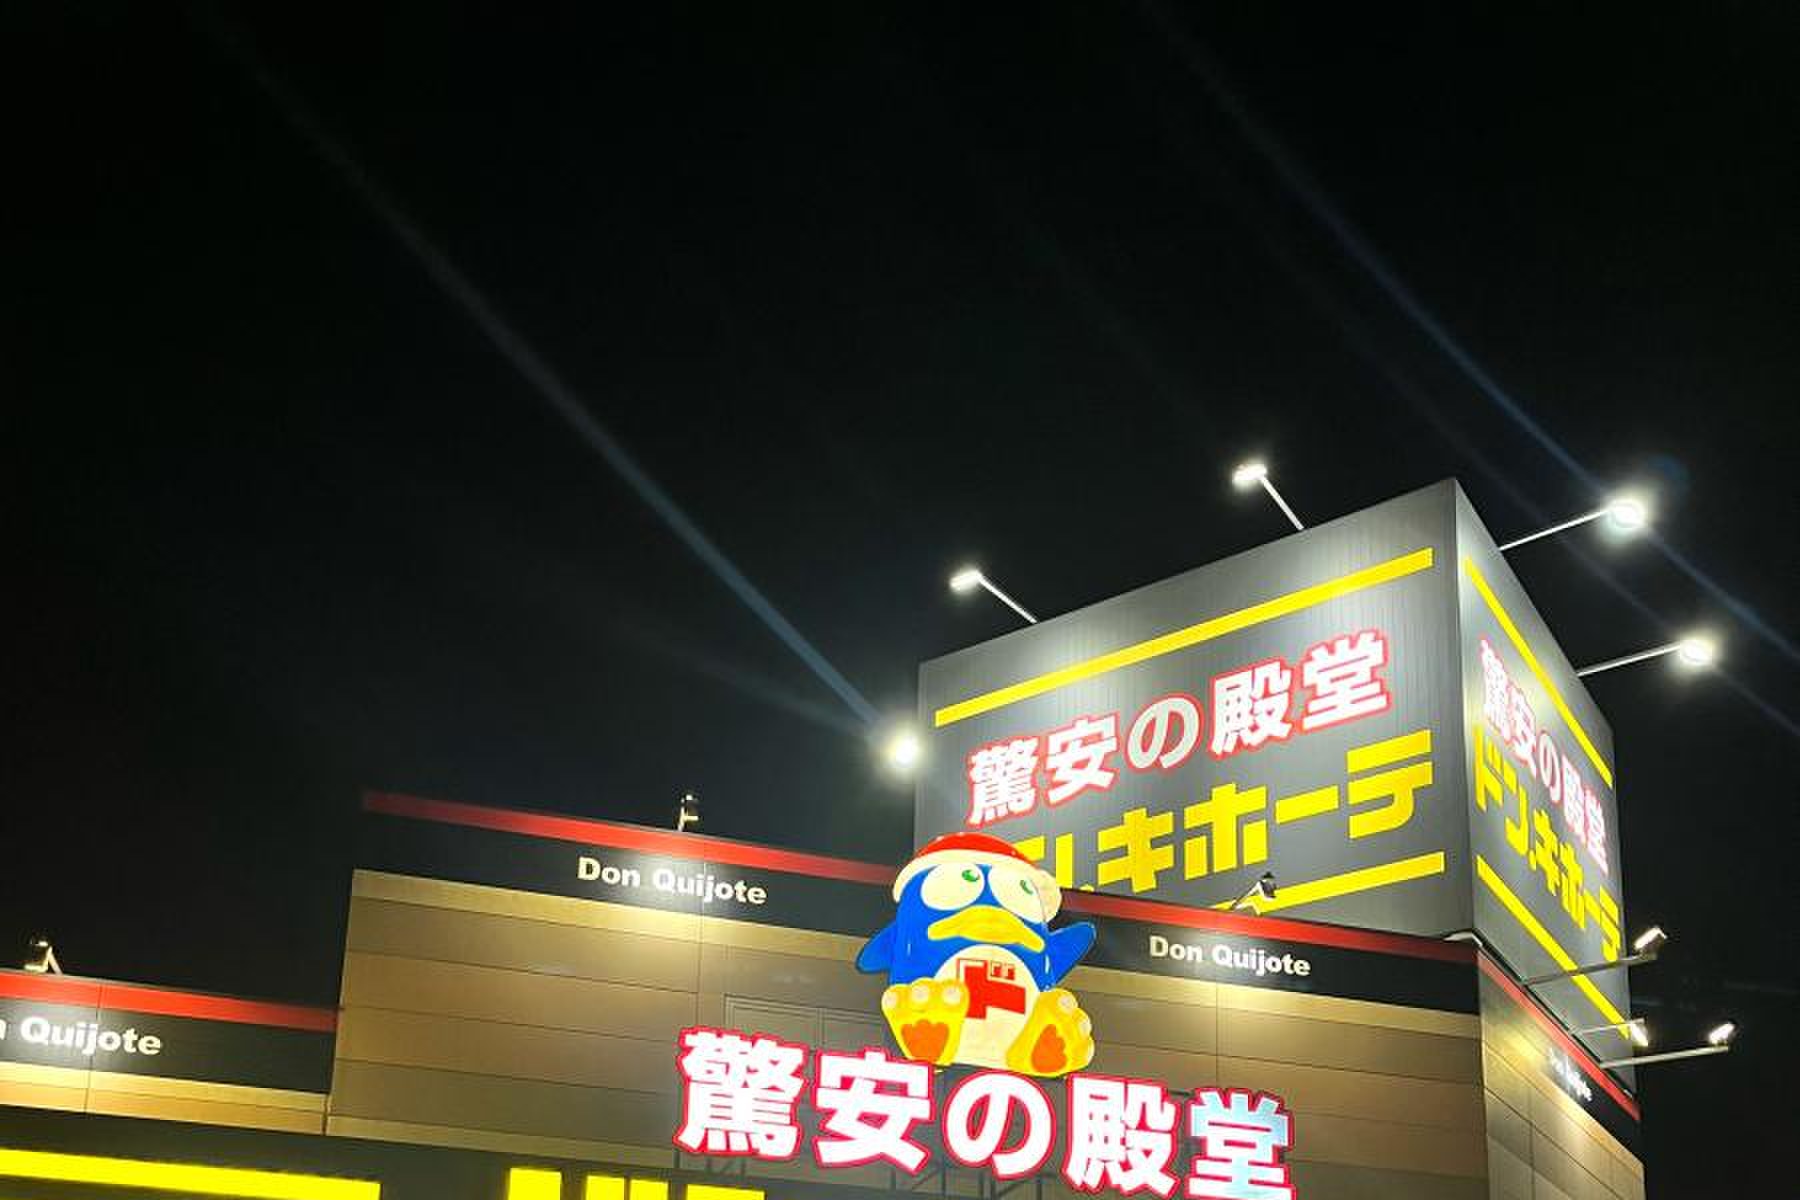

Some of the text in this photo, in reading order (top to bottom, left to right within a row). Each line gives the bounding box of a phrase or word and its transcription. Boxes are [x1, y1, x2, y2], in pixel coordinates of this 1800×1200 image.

[966, 628, 1391, 827] 驚安の殿堂
[577, 856, 768, 906] Don Quijote
[1149, 935, 1311, 978] Don Quijote
[20, 1016, 162, 1056] Quijote
